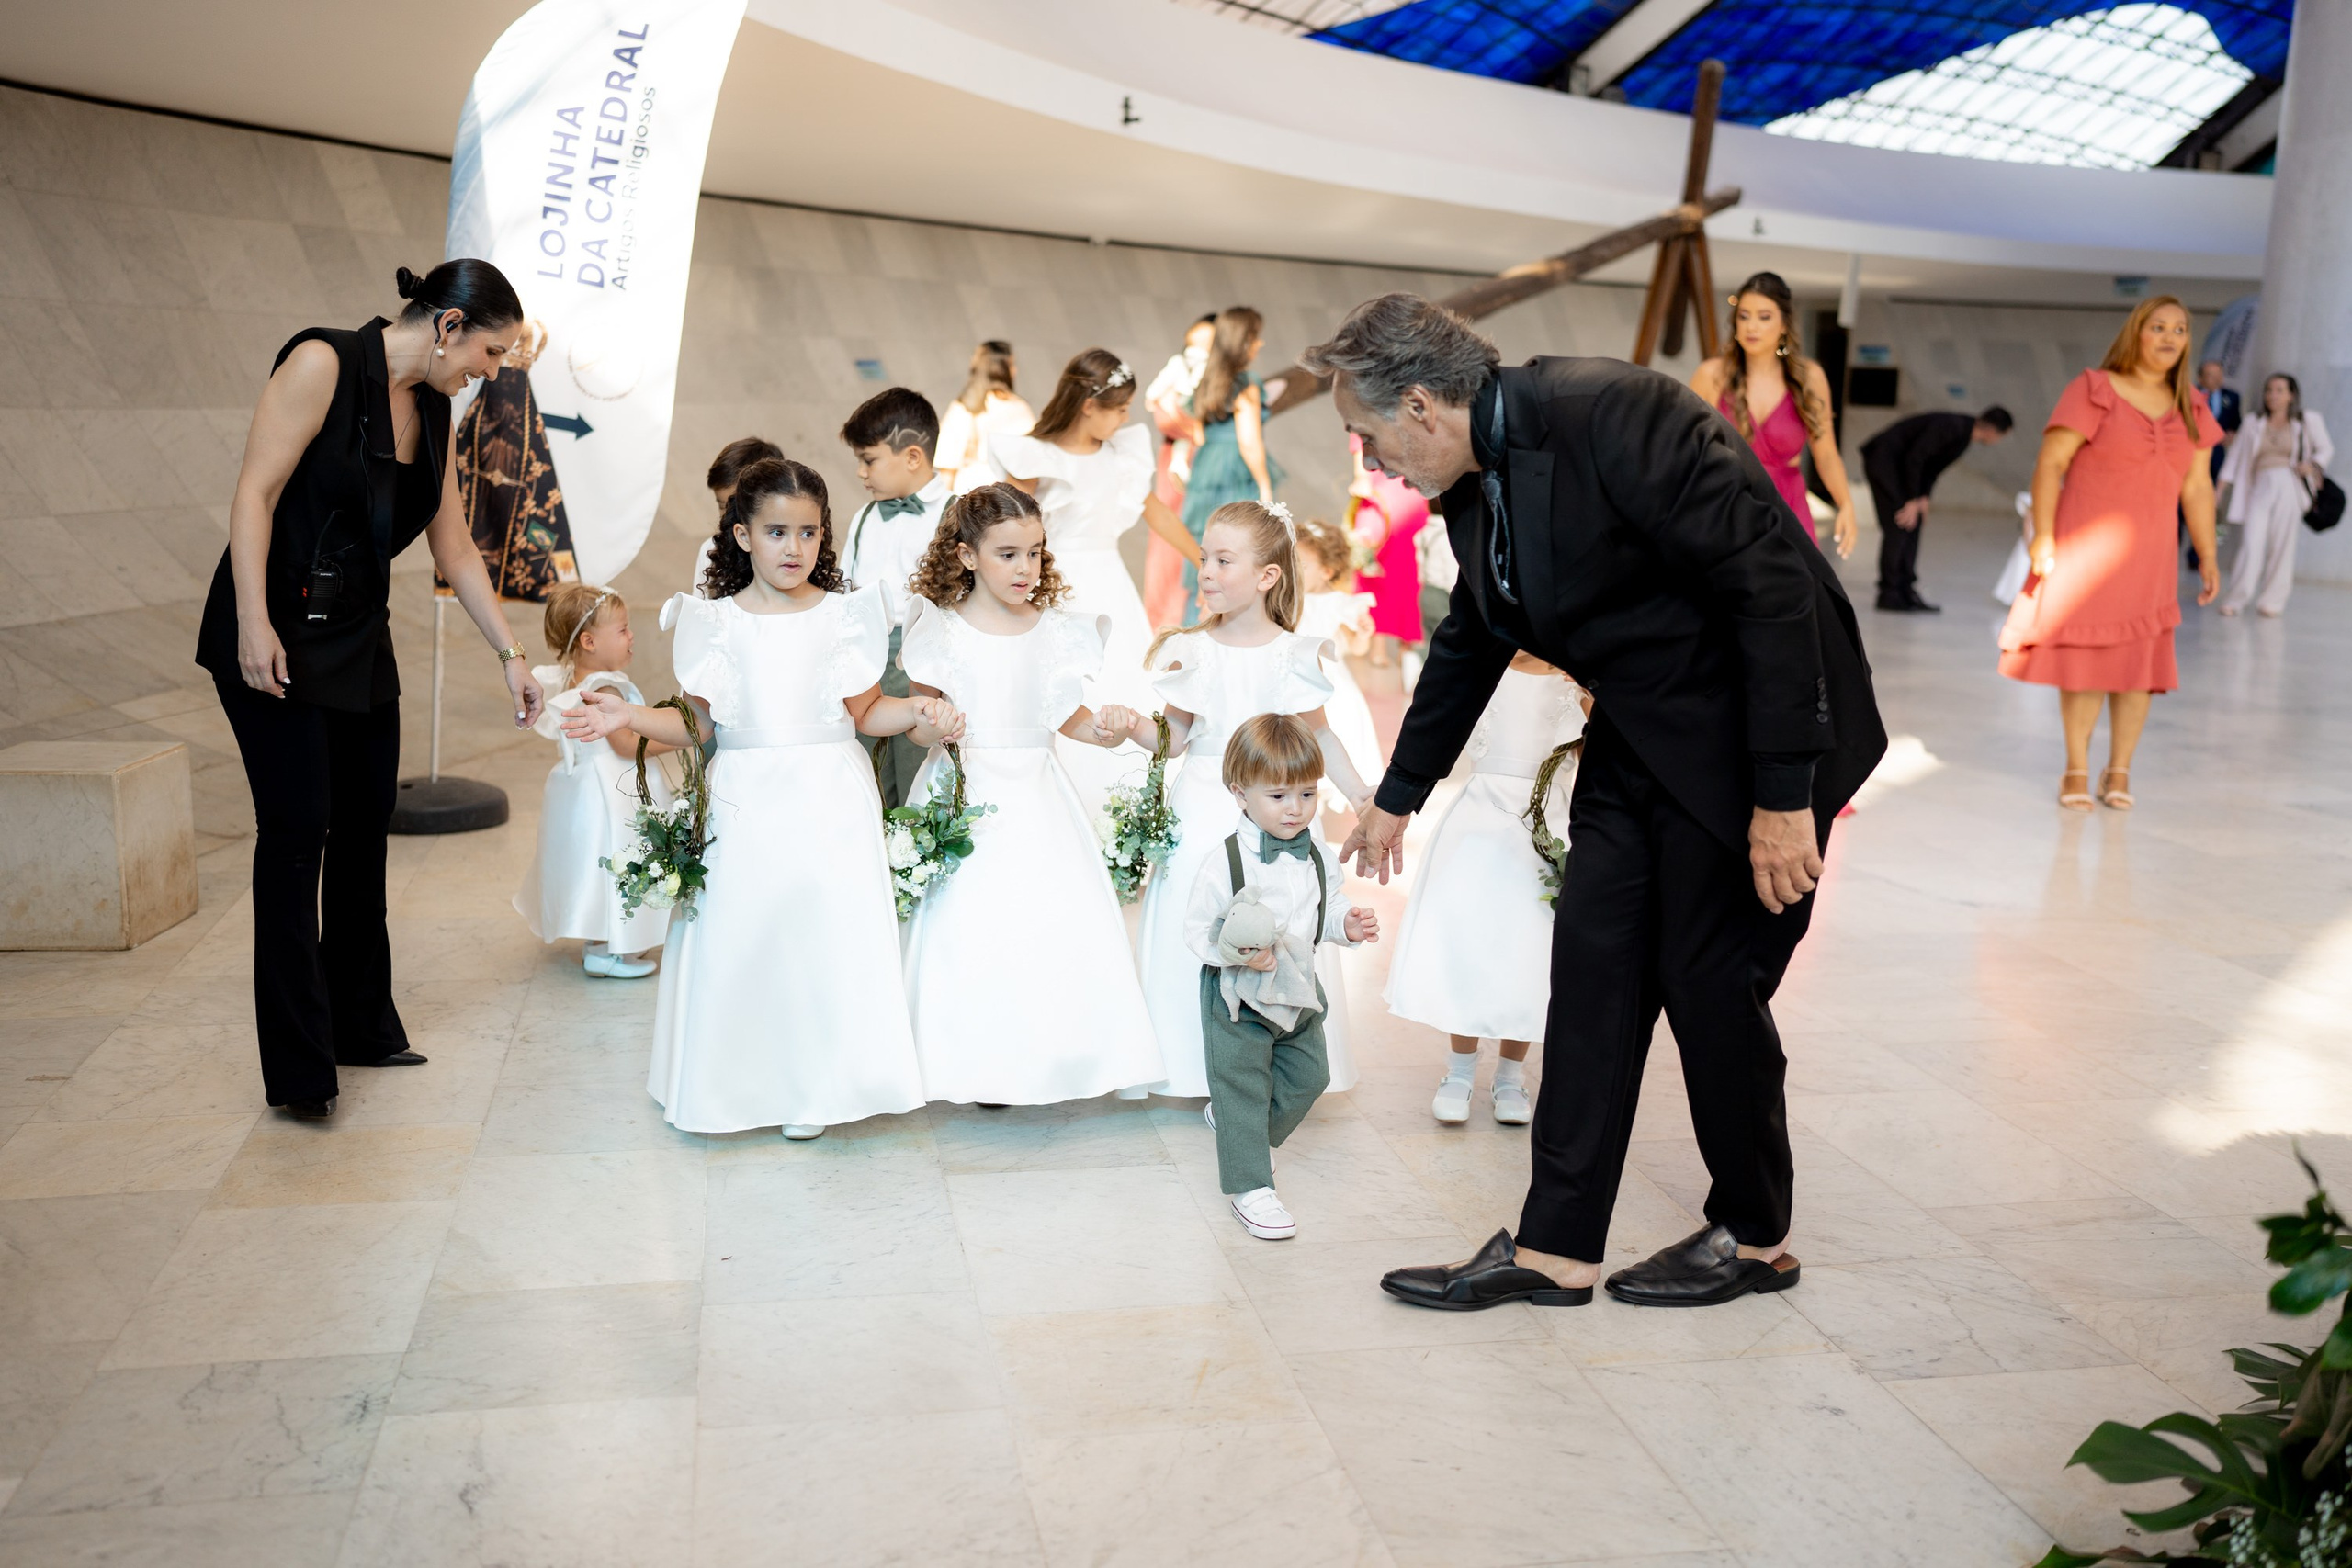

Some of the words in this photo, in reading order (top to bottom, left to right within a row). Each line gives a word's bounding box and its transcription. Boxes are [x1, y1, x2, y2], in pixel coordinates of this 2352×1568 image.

[585, 24, 650, 223] CATEDRAL
[621, 86, 656, 199] Religiosos
[537, 107, 585, 279] LOJINHA
[611, 209, 637, 290] Artigos
[577, 239, 609, 288] DA
